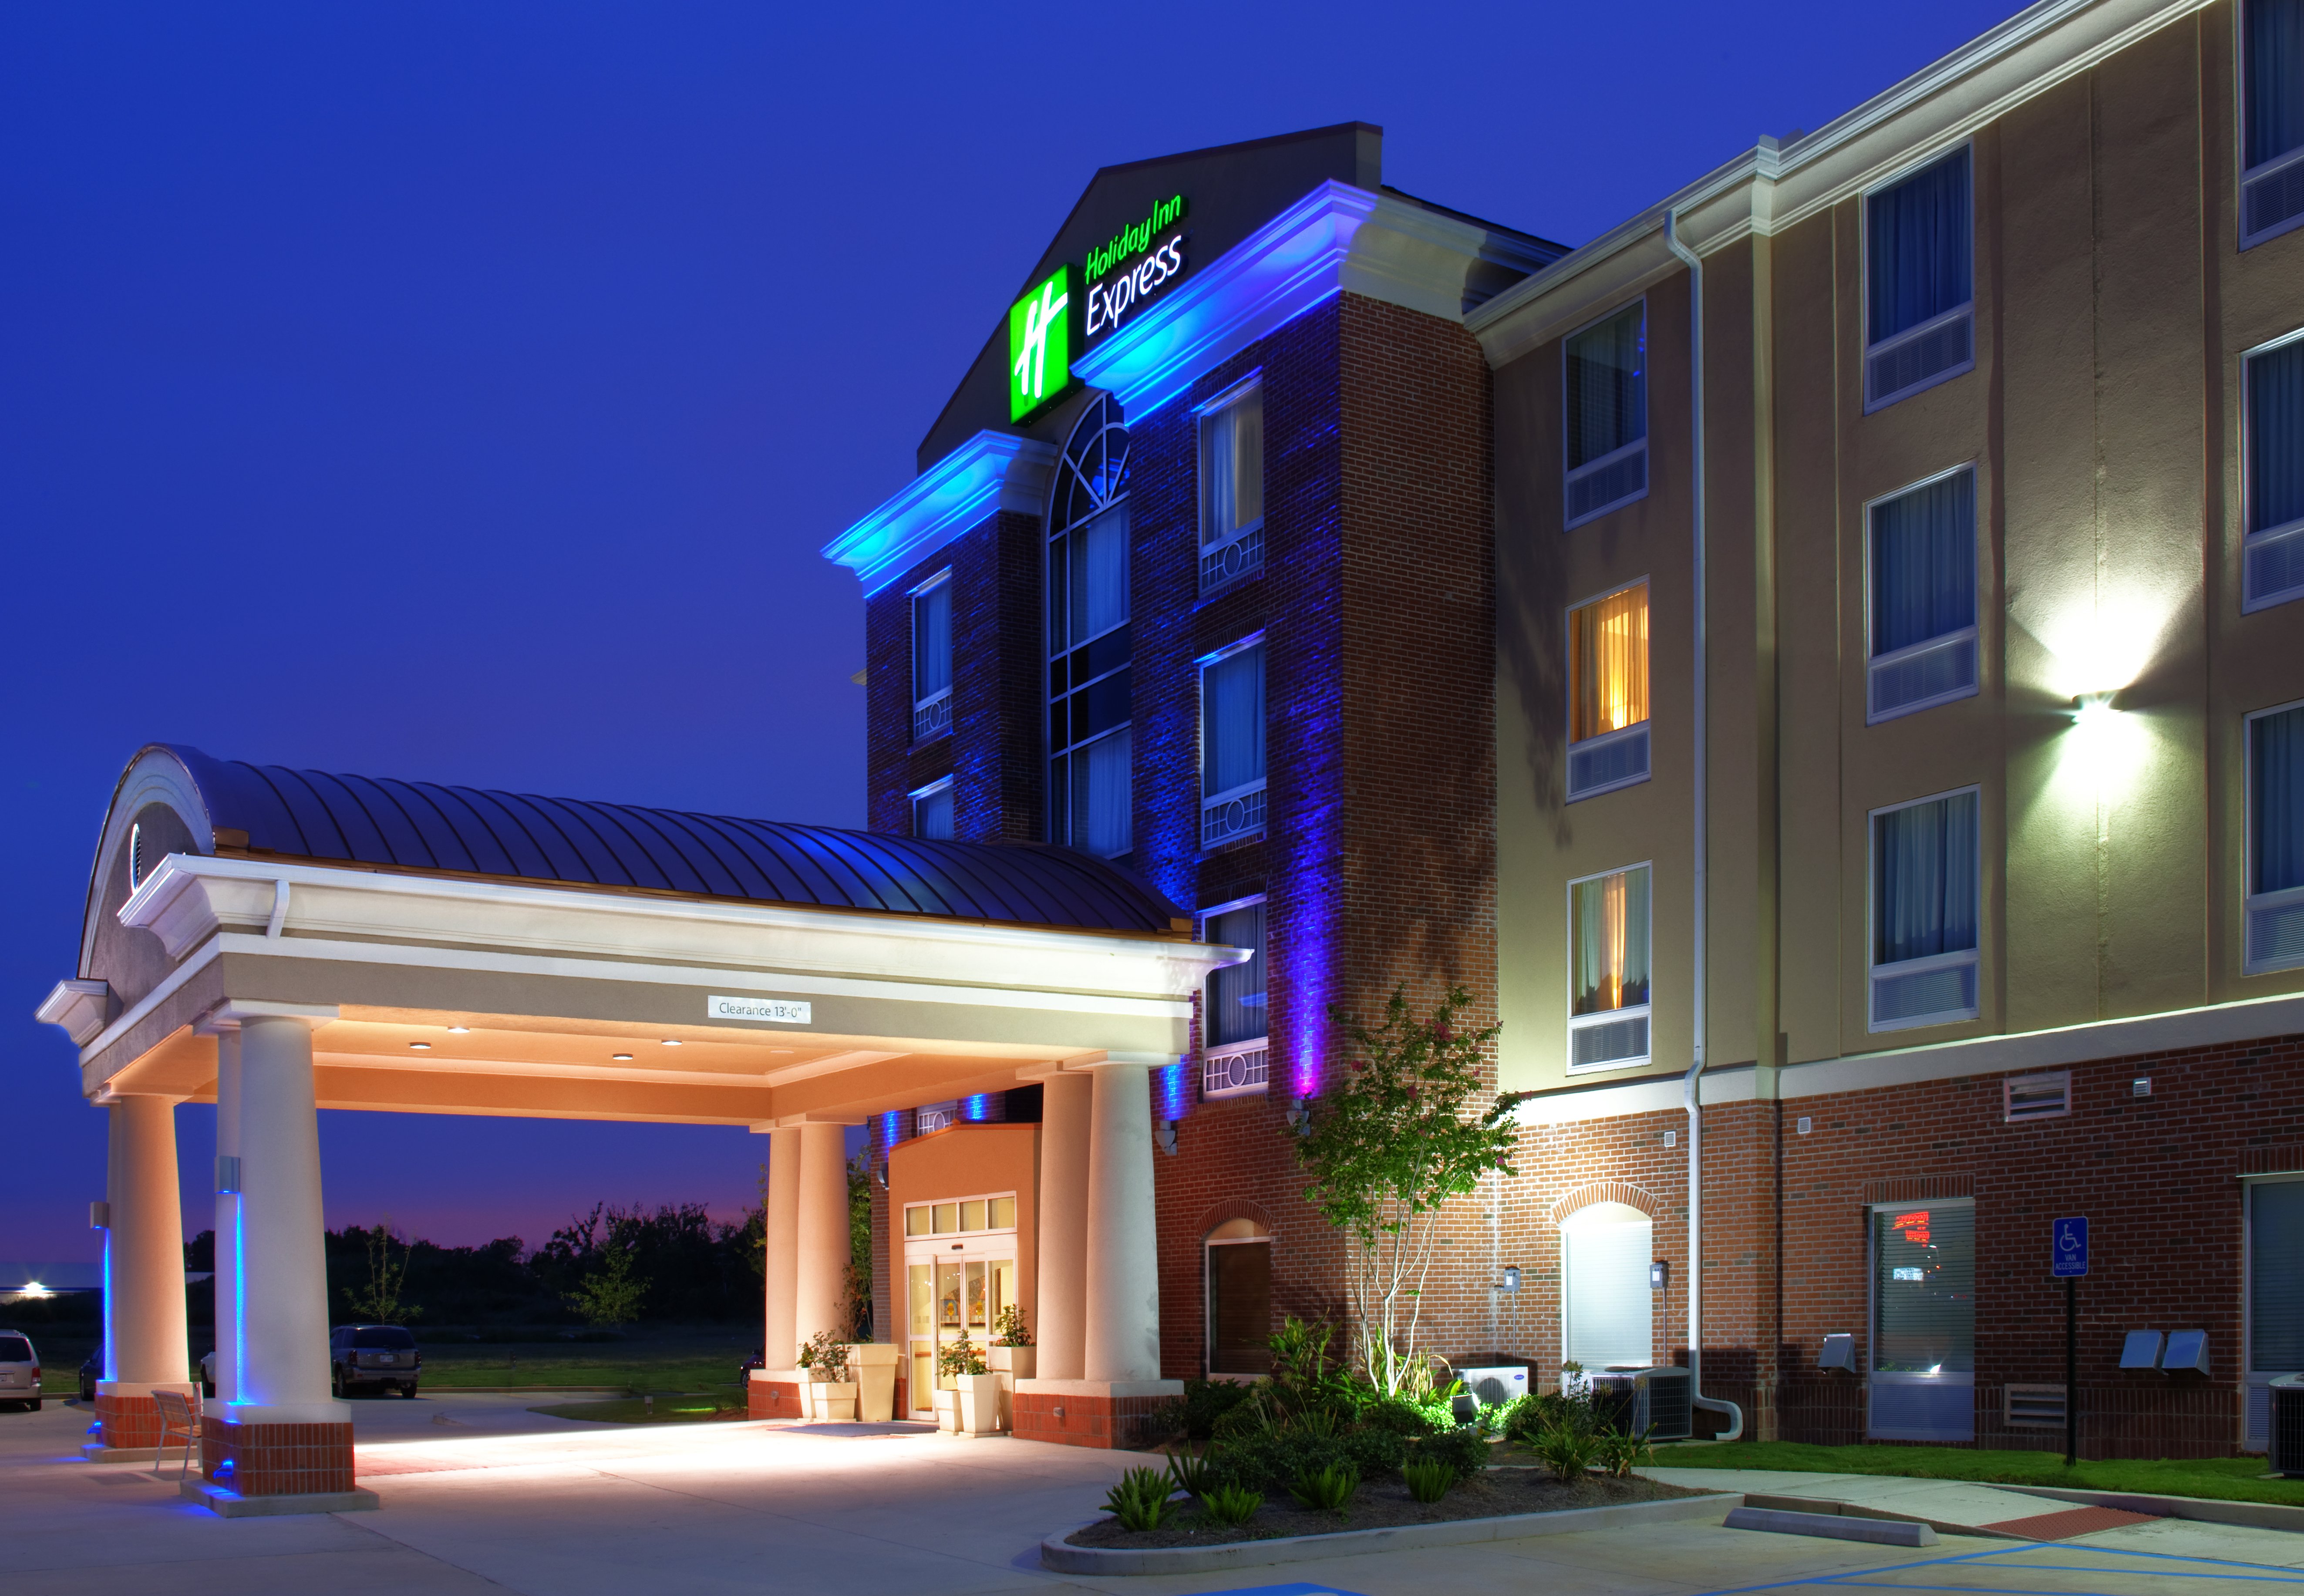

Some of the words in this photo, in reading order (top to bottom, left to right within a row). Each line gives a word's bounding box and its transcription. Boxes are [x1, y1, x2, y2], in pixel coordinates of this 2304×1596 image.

[1085, 218, 1151, 285] Holiday
[1153, 195, 1180, 234] Inn
[1087, 235, 1181, 336] Express
[719, 1003, 771, 1016] Clearance
[775, 1007, 801, 1017] 13'-0"
[2055, 1261, 2086, 1270] ACCESSIBLE
